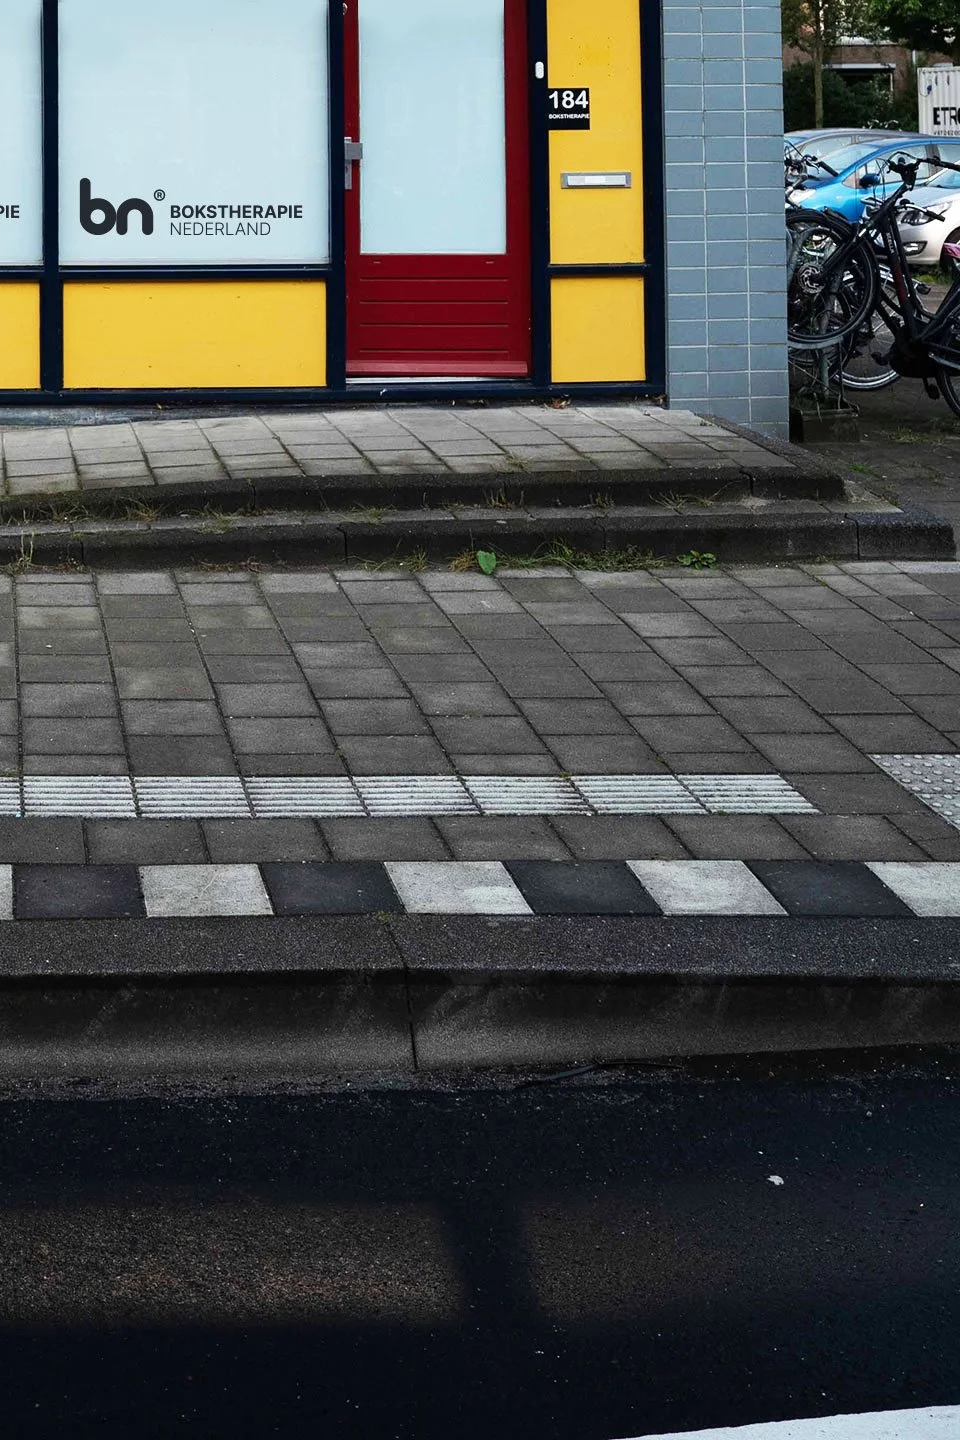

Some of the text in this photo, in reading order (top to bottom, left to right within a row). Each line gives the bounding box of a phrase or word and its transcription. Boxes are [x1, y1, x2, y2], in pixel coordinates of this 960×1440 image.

[548, 90, 589, 109] 184
[933, 106, 960, 125] ETR
[170, 204, 303, 219] BOKSTHERAPIE
[170, 221, 271, 236] NEDERLAND
